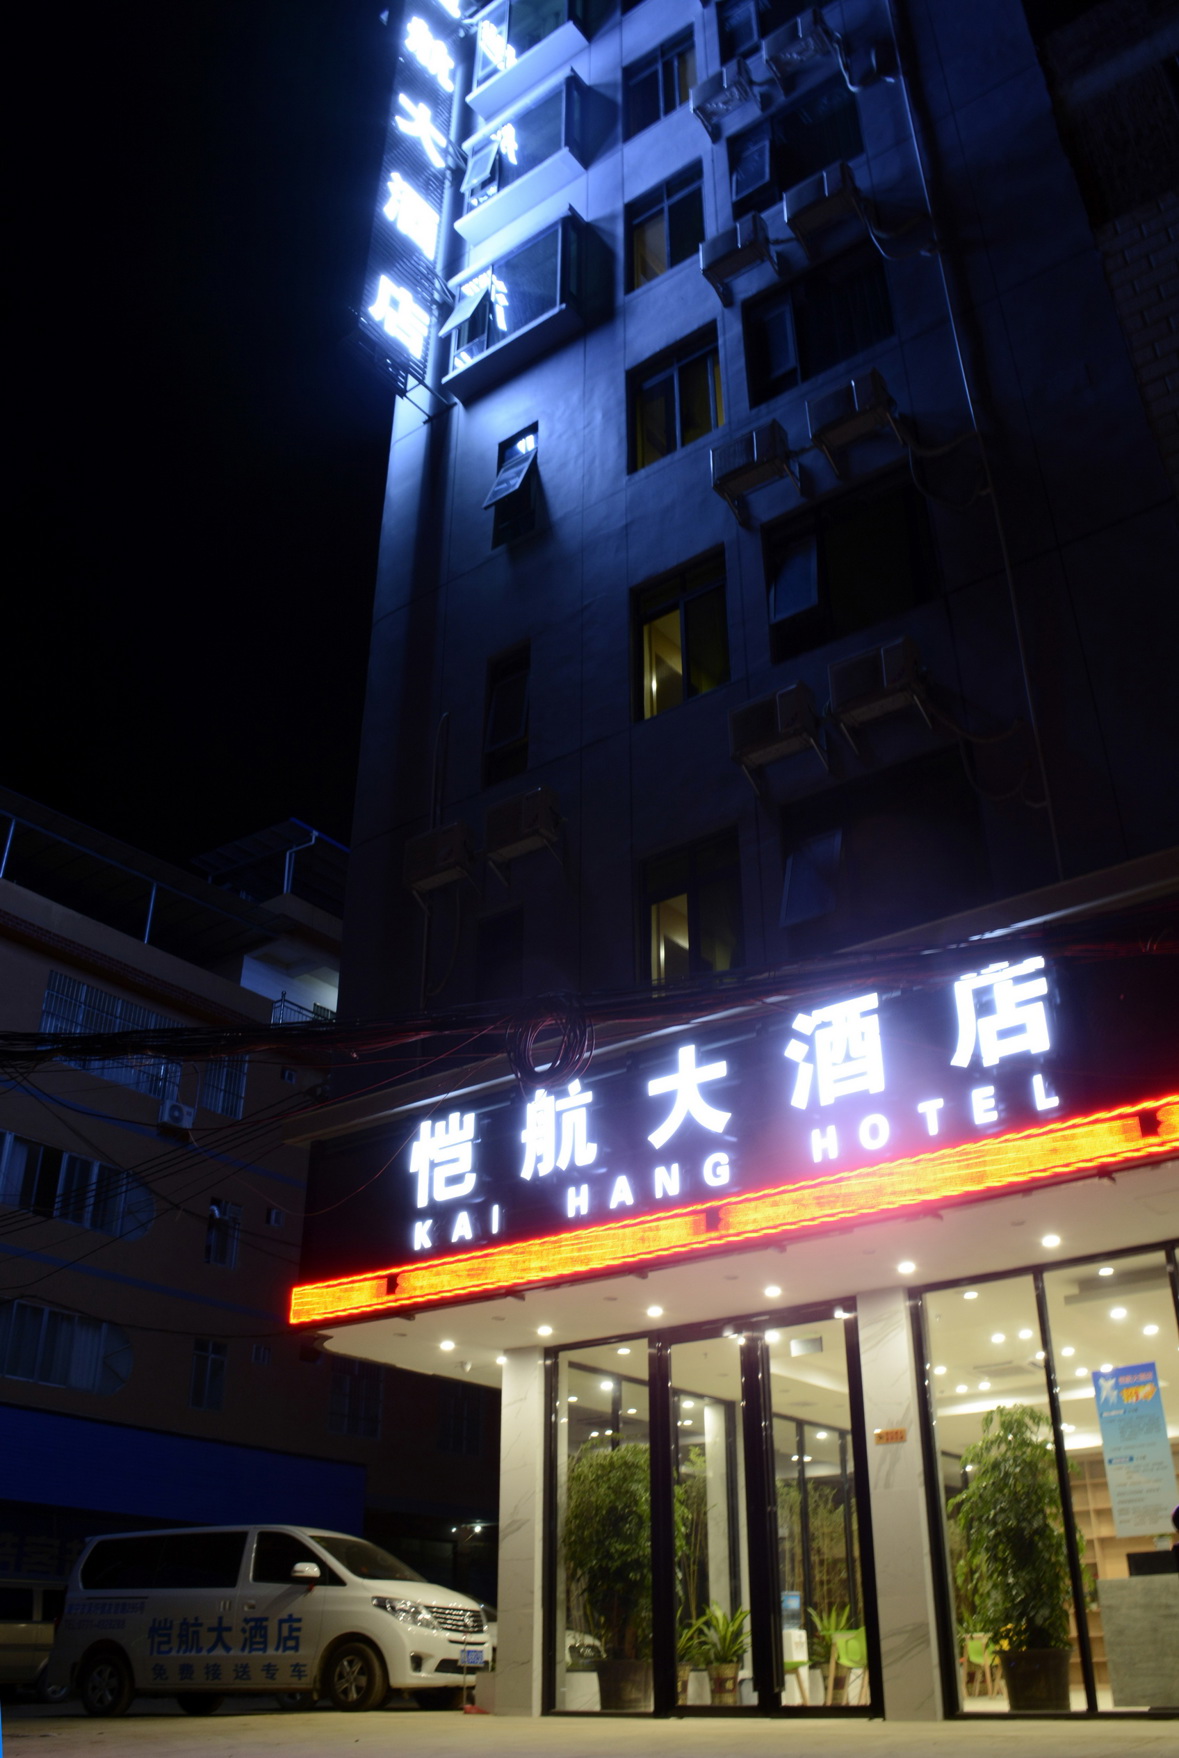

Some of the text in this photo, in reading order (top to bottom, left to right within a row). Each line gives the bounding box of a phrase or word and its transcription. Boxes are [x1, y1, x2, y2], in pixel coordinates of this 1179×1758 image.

[367, 0, 462, 360] 航大酒店
[408, 954, 1056, 1209] 恺航大酒店
[412, 1201, 500, 1251] KAI
[566, 1152, 732, 1217] HANG
[810, 1072, 1061, 1164] HOTEL
[148, 1613, 303, 1656] 恺航大酒店
[152, 1662, 309, 1681] 免费接送专车
